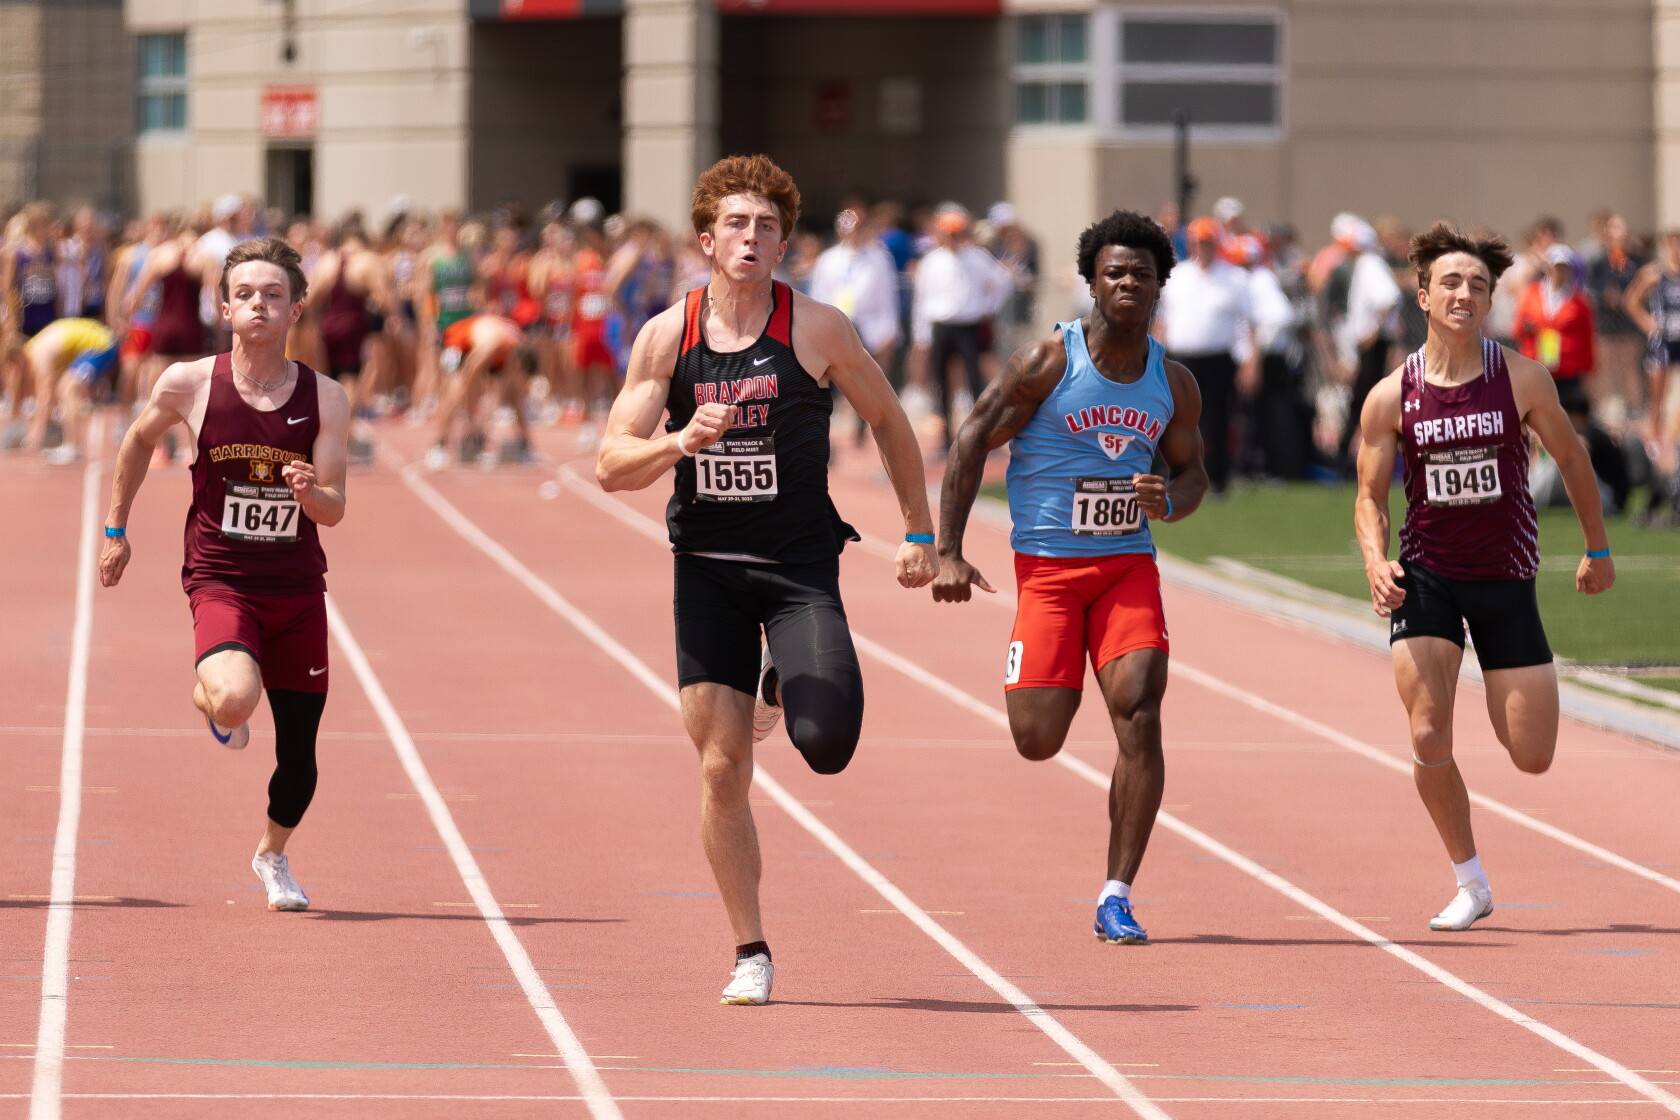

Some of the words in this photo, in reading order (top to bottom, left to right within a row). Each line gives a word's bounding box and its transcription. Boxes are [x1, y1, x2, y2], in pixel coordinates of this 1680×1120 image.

[694, 374, 778, 406] BRANDON
[730, 404, 769, 428] LEY
[1064, 404, 1162, 442] LINCOLN
[1414, 411, 1504, 446] SPEARFISH
[1104, 434, 1123, 454] SF
[700, 458, 774, 491] 1555
[1430, 464, 1496, 496] 1949
[229, 502, 296, 532] 1647
[1078, 497, 1138, 526] 1860
